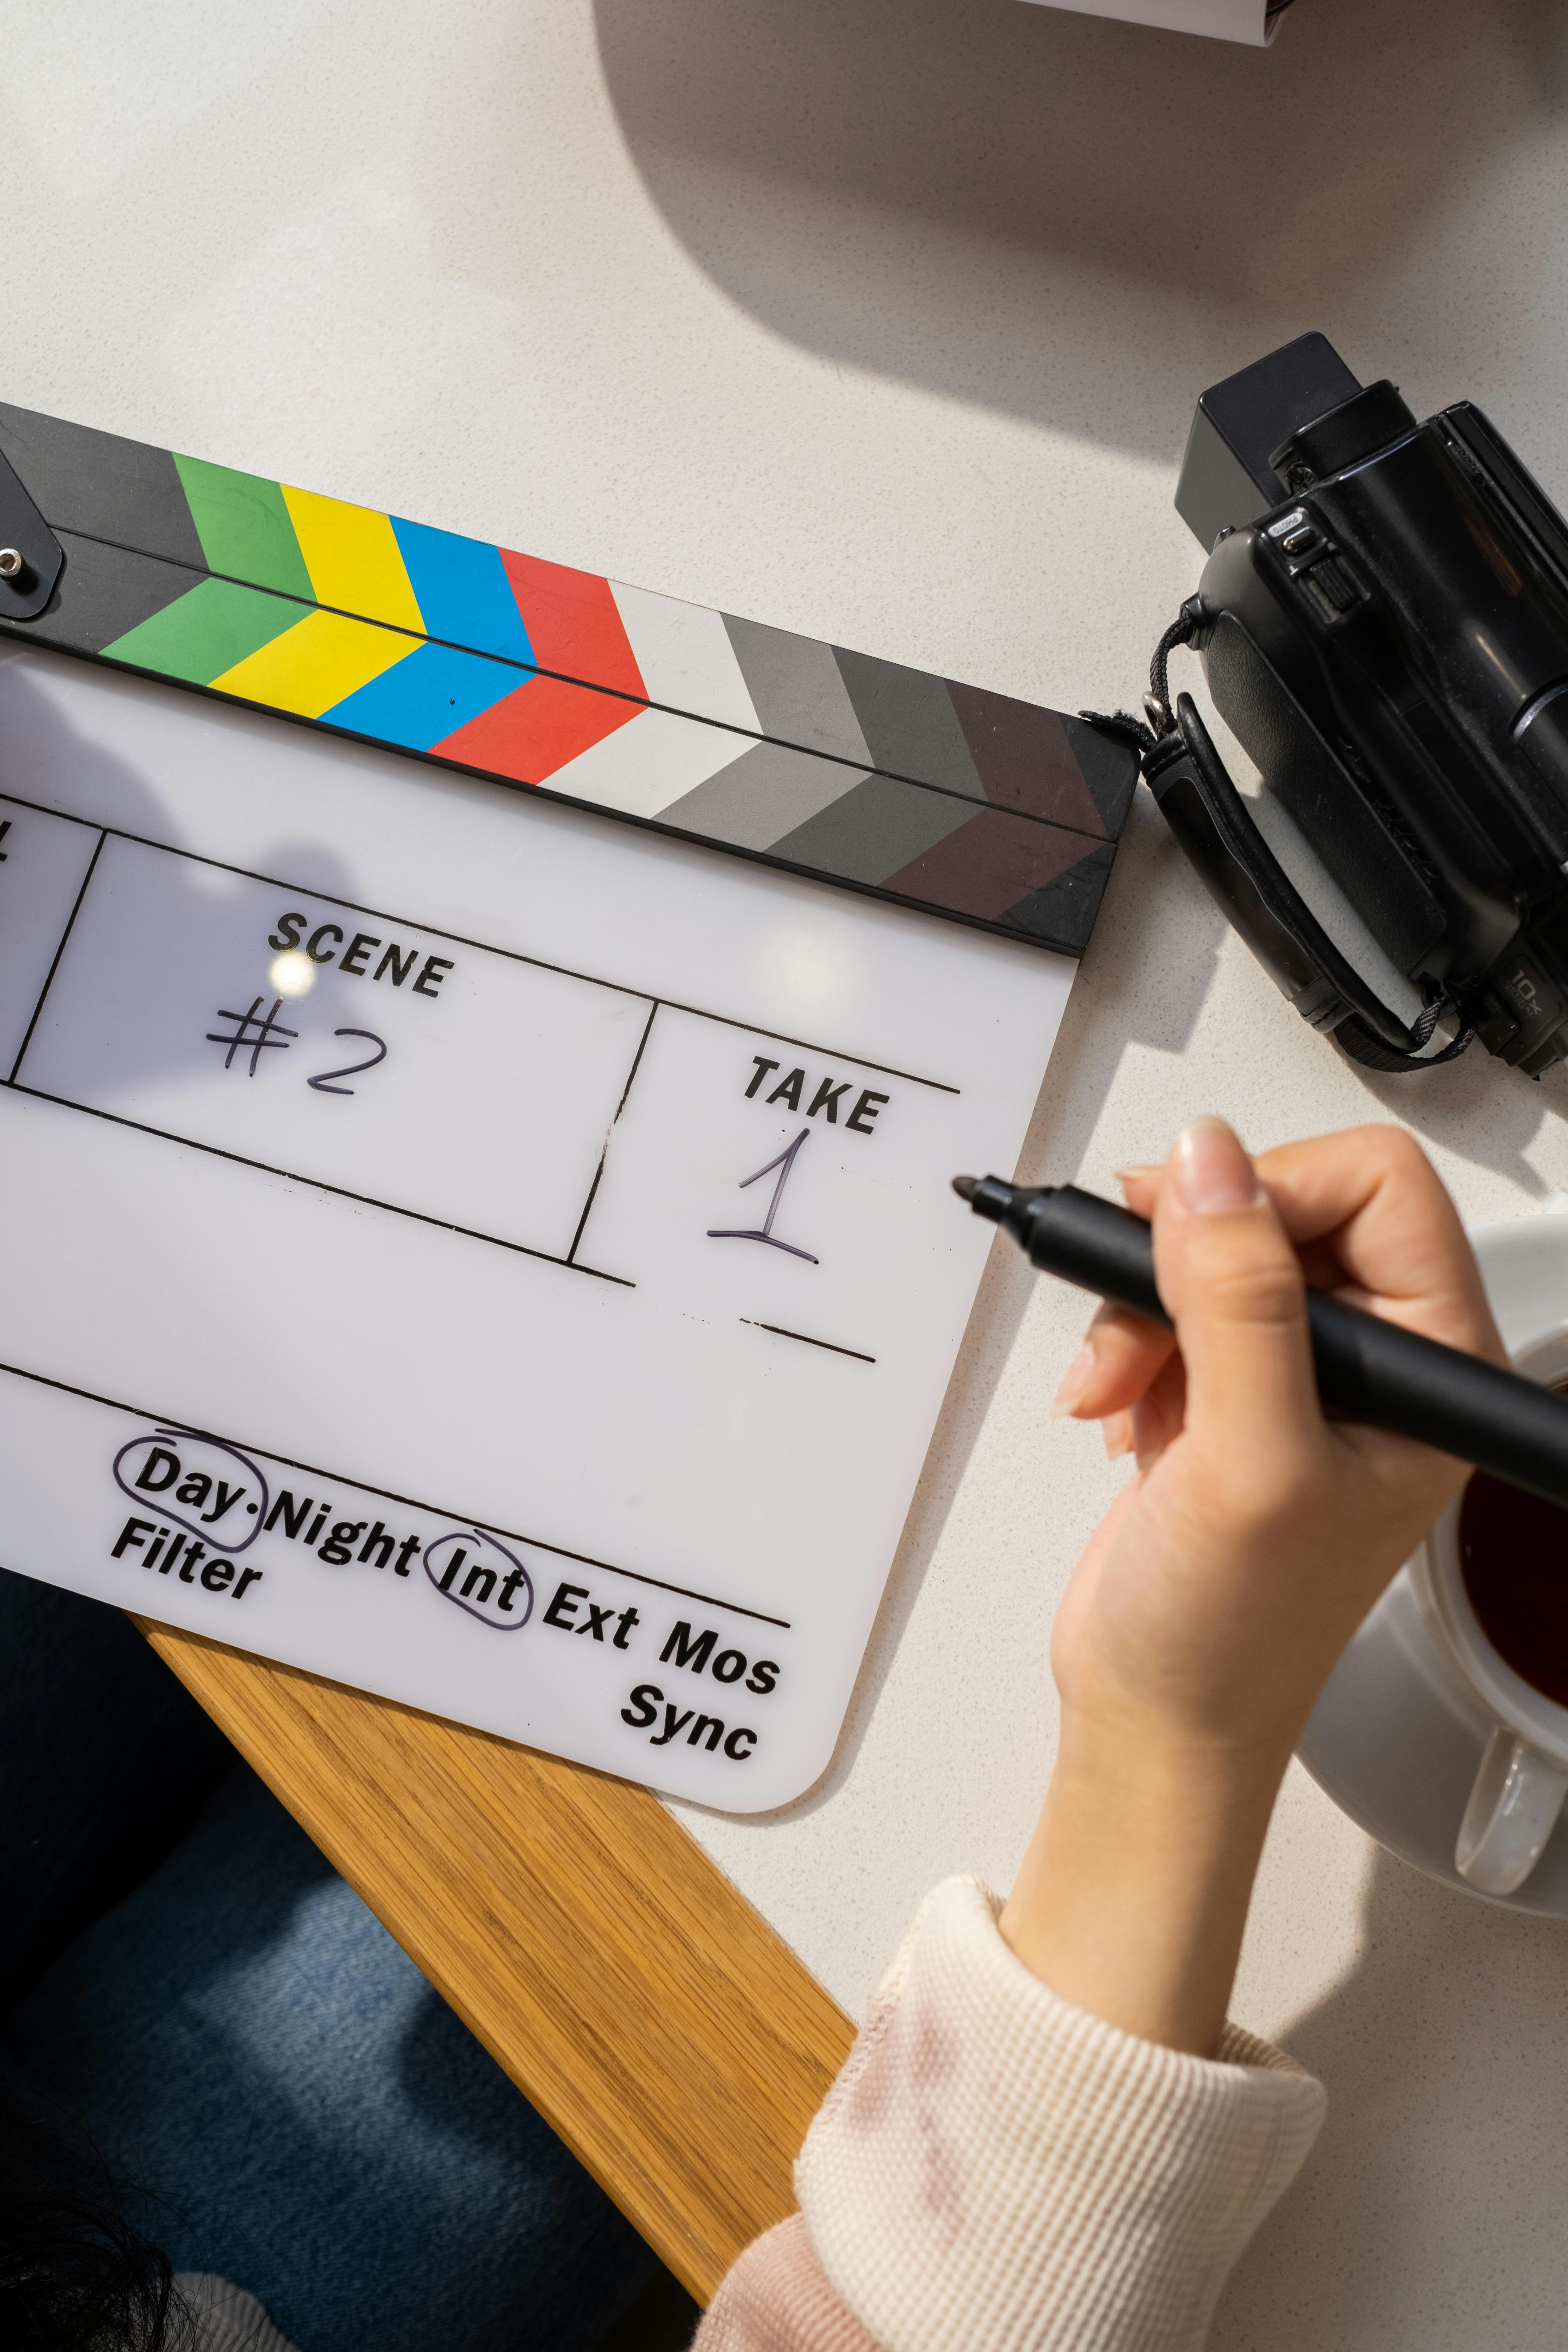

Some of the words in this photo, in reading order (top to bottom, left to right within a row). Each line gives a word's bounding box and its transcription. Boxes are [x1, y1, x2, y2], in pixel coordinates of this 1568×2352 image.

[1273, 515, 1297, 533] PHOTO
[268, 913, 455, 998] SCENE
[1510, 969, 1542, 1015] 10x
[745, 1056, 890, 1135] TAKE
[706, 1128, 819, 1265] 1
[111, 1517, 263, 1599] Filter
[438, 1548, 525, 1612] Int
[543, 1582, 640, 1650] Ext
[659, 1620, 780, 1694] Mos
[620, 1684, 757, 1760] Sync
